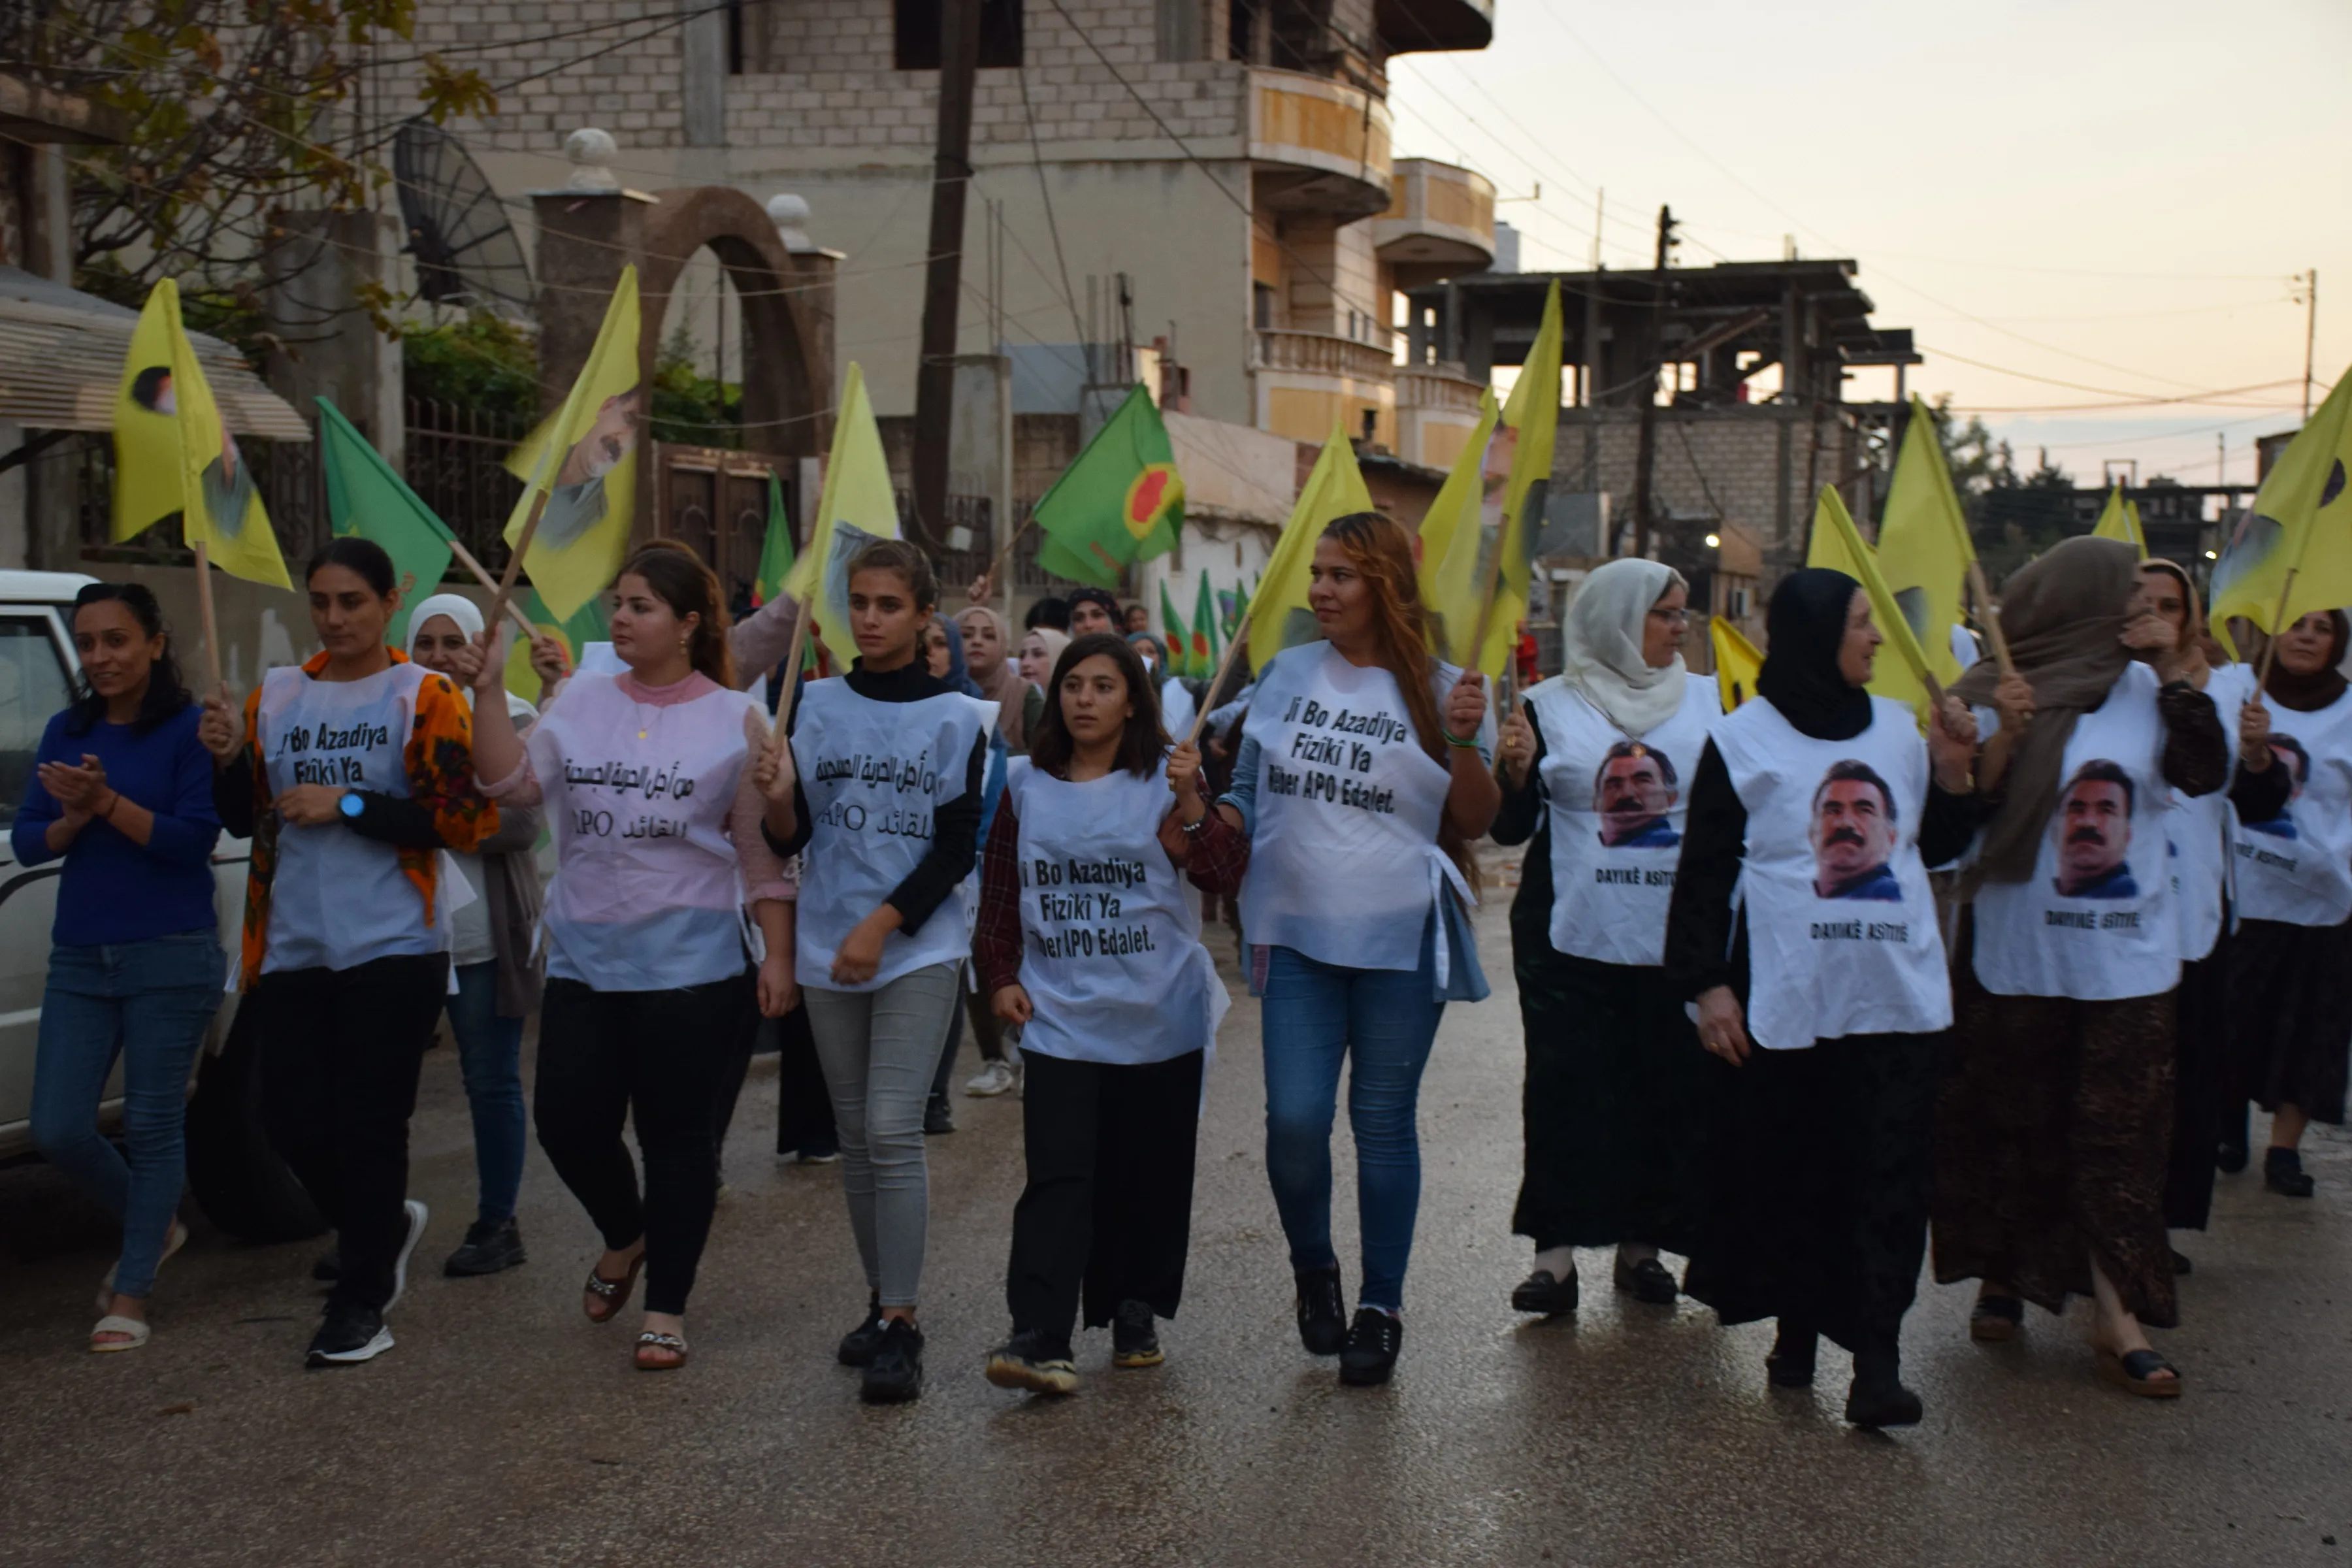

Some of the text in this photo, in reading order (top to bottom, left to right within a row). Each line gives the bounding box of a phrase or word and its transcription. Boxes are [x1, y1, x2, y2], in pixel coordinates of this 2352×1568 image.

[1284, 696, 1407, 745] Ji Bo Azadiya
[291, 726, 310, 753] Bo
[316, 722, 387, 751] Azadiya
[1291, 732, 1371, 773] Fizîkî Ya
[340, 756, 363, 783] Ya
[1303, 770, 1336, 802] APO
[1341, 779, 1394, 813] Edalet.
[1036, 860, 1062, 885] Bo
[1069, 858, 1146, 889] Azadiya
[1040, 892, 1120, 921] Fizîkî Ya
[1098, 925, 1155, 955] Edalet.
